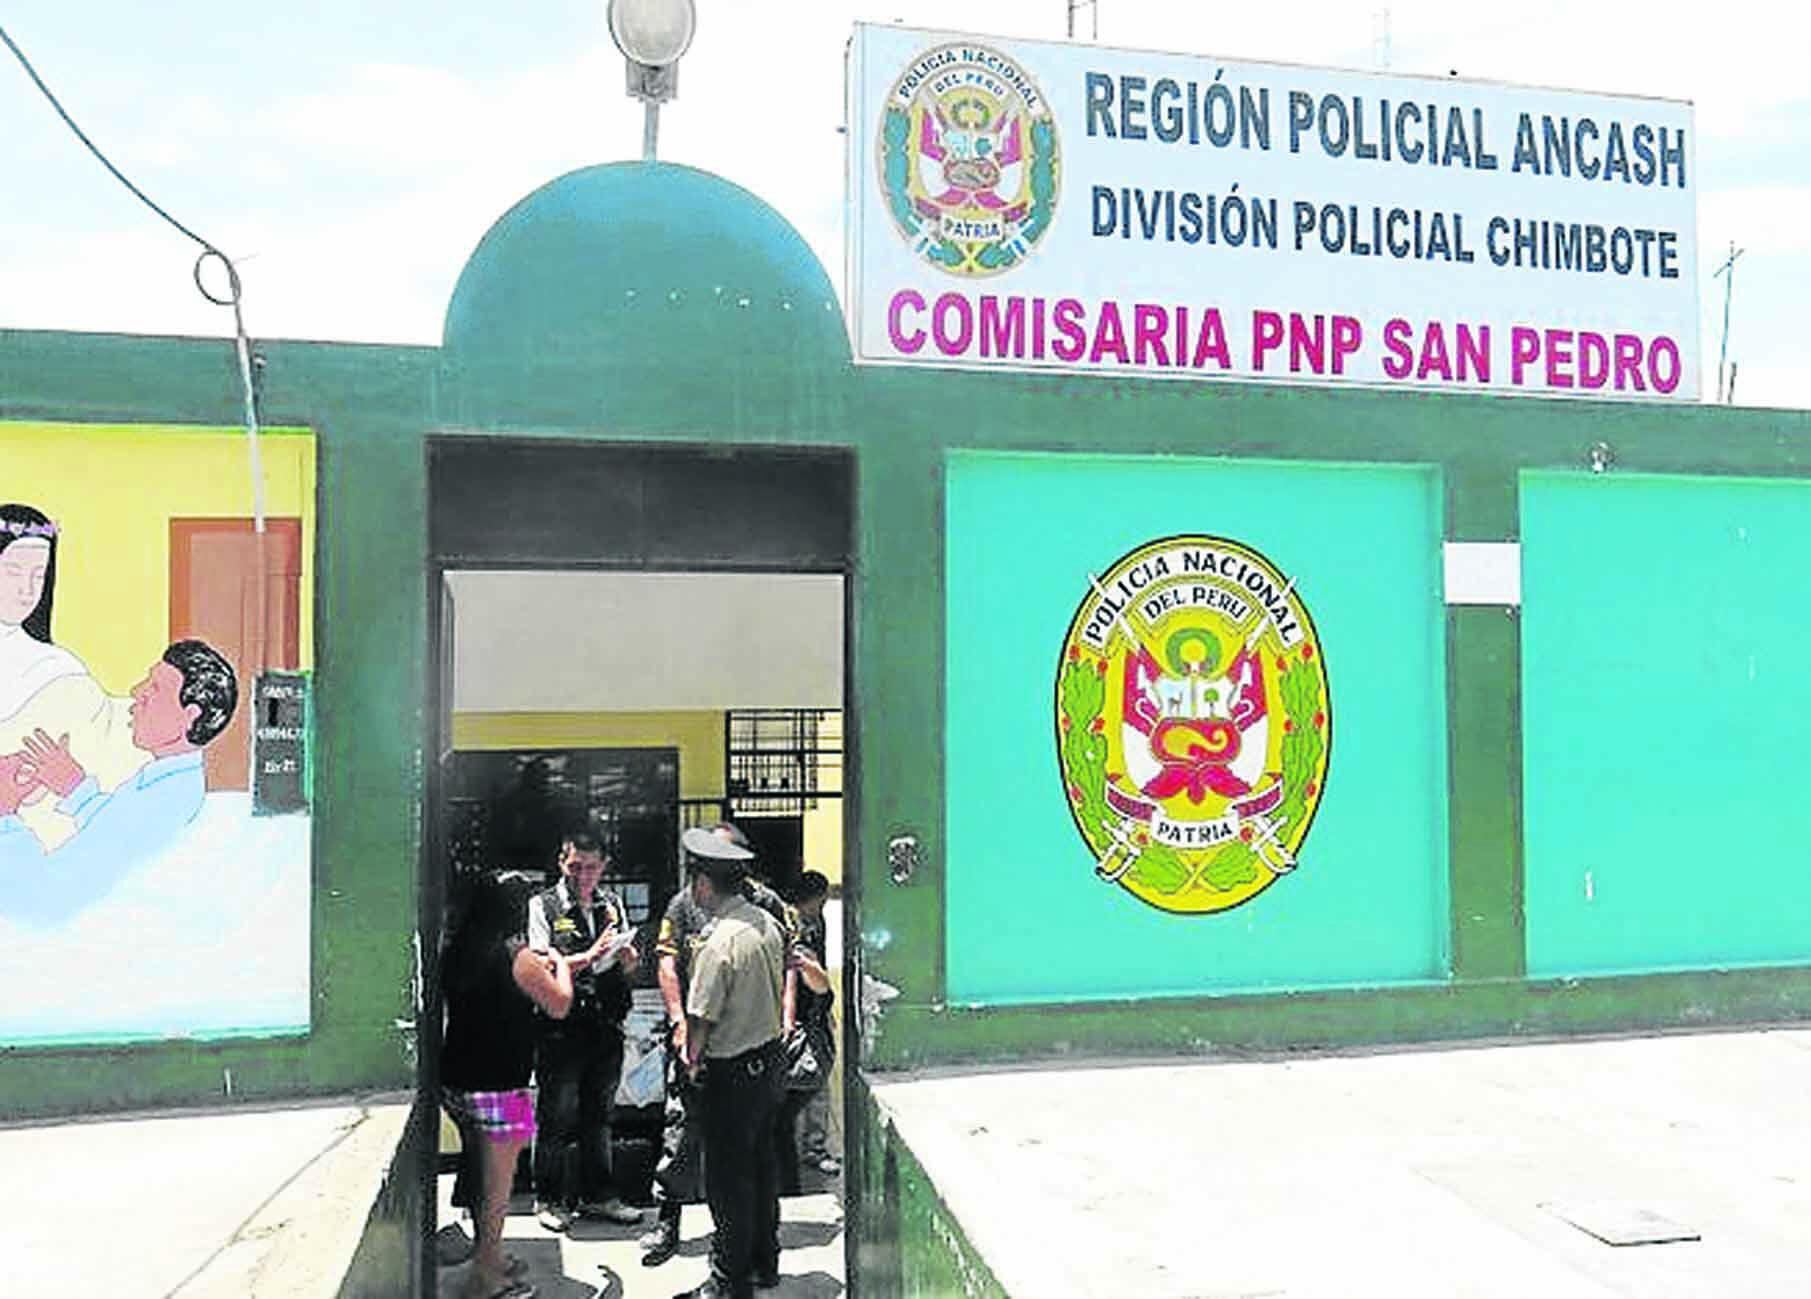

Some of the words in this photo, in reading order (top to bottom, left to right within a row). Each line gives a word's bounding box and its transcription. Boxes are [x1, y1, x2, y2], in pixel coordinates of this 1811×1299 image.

[899, 51, 956, 98] POLICIA
[963, 49, 1037, 108] NACIONAL
[935, 73, 961, 92] DEL
[1085, 69, 1270, 150] REGIÓN
[1289, 90, 1498, 170] POLICIAL
[1512, 113, 1686, 188] ANCASH
[944, 218, 1000, 238] PATRIA
[1091, 183, 1278, 249] DIVISIÓN
[1294, 201, 1474, 263] POLICIAL
[1487, 216, 1679, 278] CHIMBOTE
[888, 289, 1231, 369] COMISARIA
[1252, 310, 1362, 375] PNP
[1383, 318, 1490, 383] SAN
[1511, 327, 1681, 394] PEDRO
[1085, 556, 1170, 642] POLICIA
[1183, 551, 1297, 642] NACIONAL
[1144, 588, 1185, 619] DEL
[1192, 587, 1247, 619] PERU
[1157, 821, 1233, 844] PATRIA
